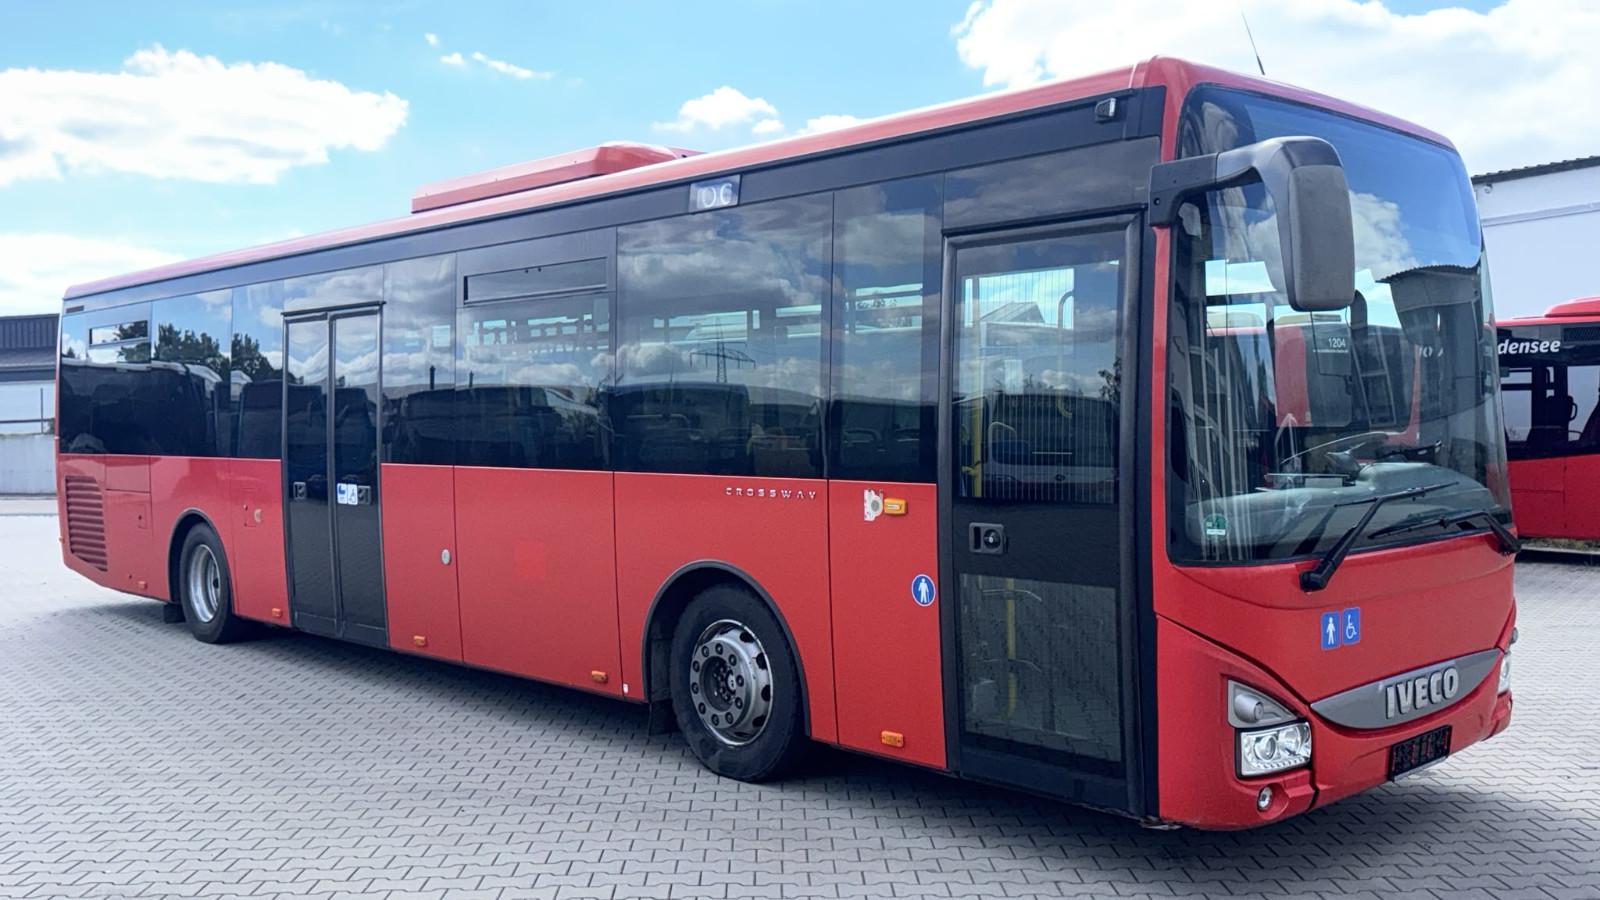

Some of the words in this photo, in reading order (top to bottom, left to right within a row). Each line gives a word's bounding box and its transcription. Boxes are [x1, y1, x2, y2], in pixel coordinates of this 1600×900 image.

[1328, 337, 1346, 349] 1204
[725, 487, 816, 500] CROSSWAY
[1385, 667, 1459, 719] IVECO
